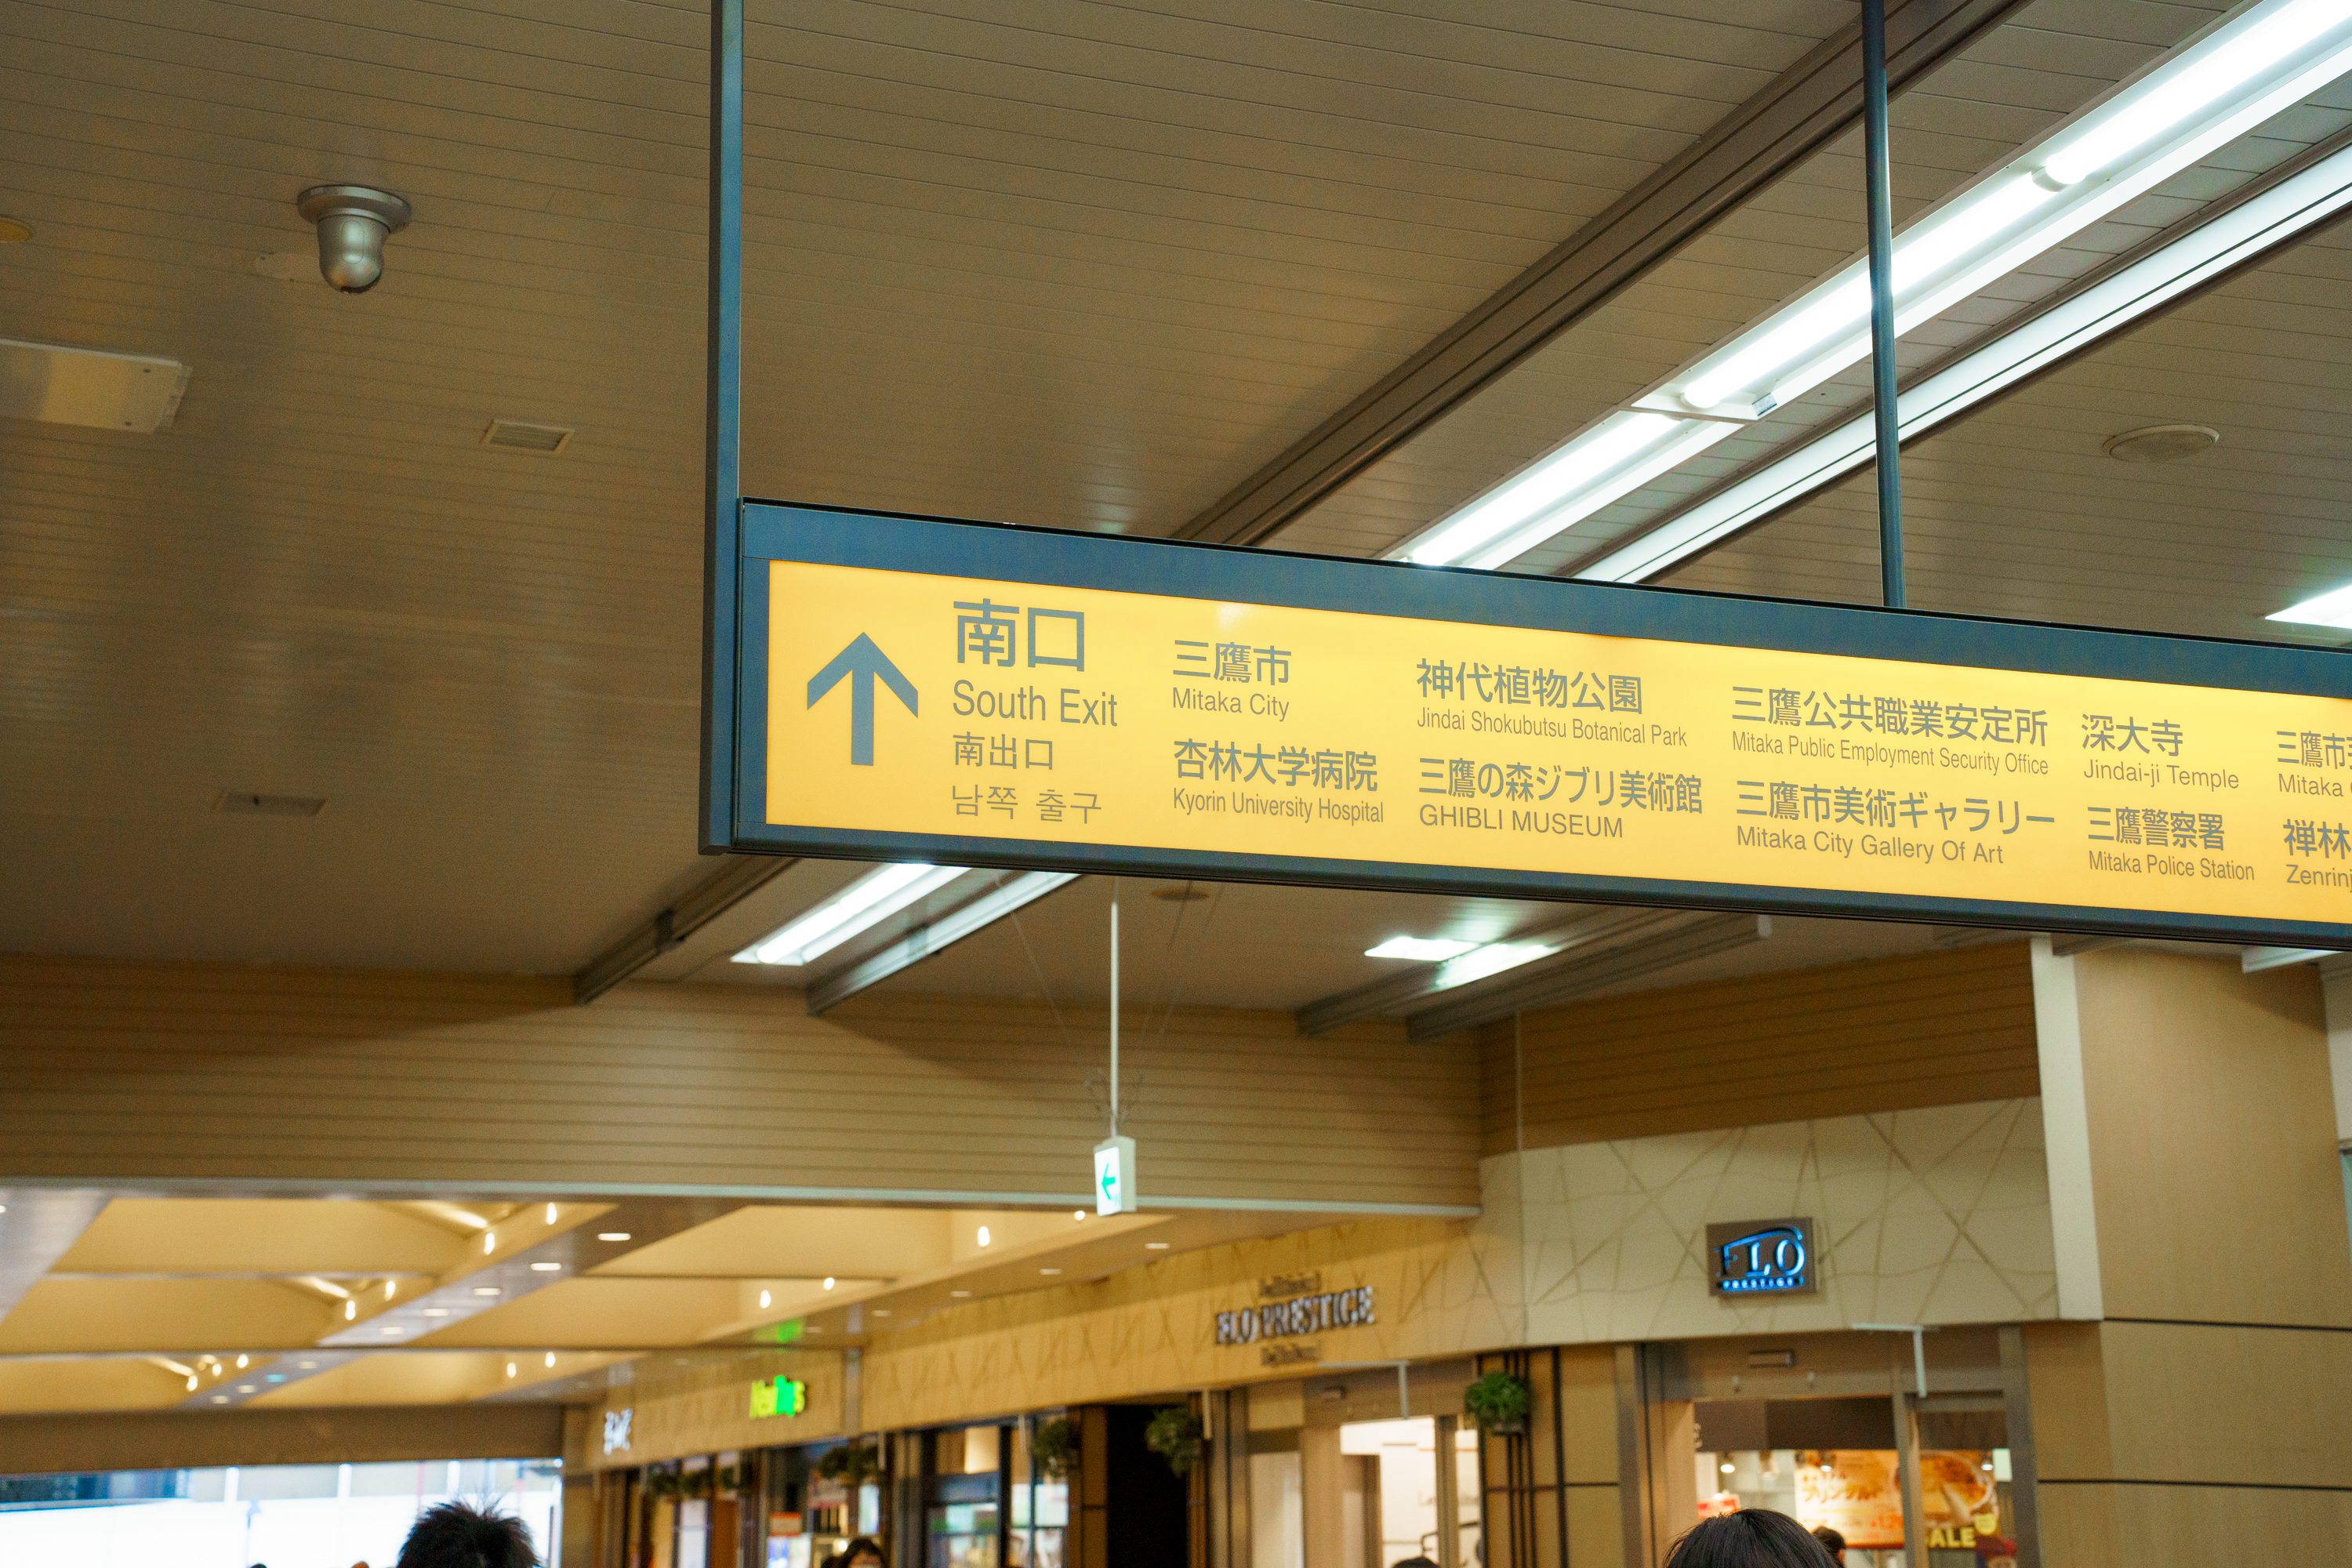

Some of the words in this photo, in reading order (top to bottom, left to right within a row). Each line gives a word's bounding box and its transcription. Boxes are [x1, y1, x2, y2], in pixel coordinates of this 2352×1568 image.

[953, 598, 1084, 672] 南口
[1173, 640, 1291, 685] 三鷹市
[953, 680, 1045, 720] South
[1061, 688, 1117, 726] Exit
[1173, 688, 1242, 713] Mitaka
[1250, 694, 1289, 722] City
[1417, 659, 1642, 714] 神代植物公園
[1417, 707, 1465, 730] Jindai
[1472, 711, 1566, 737] Shokubutsu
[1573, 719, 1645, 743] Botanical
[1652, 724, 1687, 746] Park
[1733, 687, 2048, 746] 三鷹公共職業安定所
[2082, 714, 2183, 757] 深大寺
[953, 731, 1052, 770] 南出口
[1174, 739, 1377, 791] 杏林大学病院
[1733, 731, 1784, 754] Mitaka
[1789, 735, 1835, 758] Public
[1841, 740, 1934, 768] Employment
[1940, 748, 1999, 775] Security
[2005, 753, 2048, 775] Office
[2277, 731, 2352, 770] 三鷹市
[1419, 758, 1702, 814] 三鷹の森ジブリ美術館
[2084, 760, 2160, 787] Jindai-ji
[2167, 765, 2238, 792] Temple
[2279, 774, 2343, 797] Mitaka
[953, 785, 1018, 819] 남쪽
[1036, 789, 1102, 824] 출구
[1174, 788, 1225, 815] Kyorin
[1233, 792, 1312, 823] University
[1319, 798, 1383, 826] Hospital
[1420, 804, 1502, 829] GHIBLI
[1512, 811, 1622, 837] MUSEUM
[1737, 781, 2055, 834] 三鷹市美術ギャラリー
[1737, 826, 1806, 850] Mitaka
[1814, 831, 1853, 858] City
[1861, 835, 1934, 864] Gallery
[1942, 840, 1965, 861] Of
[1973, 843, 2003, 863] Art
[2088, 807, 2224, 851] 三鷹警察署
[2089, 851, 2142, 873] Mitaka
[2147, 855, 2194, 877] Police
[2201, 858, 2254, 880] Station
[1715, 1225, 1806, 1277] FLO
[1216, 1308, 1259, 1345] FLO
[1925, 1526, 1976, 1548] ALE
